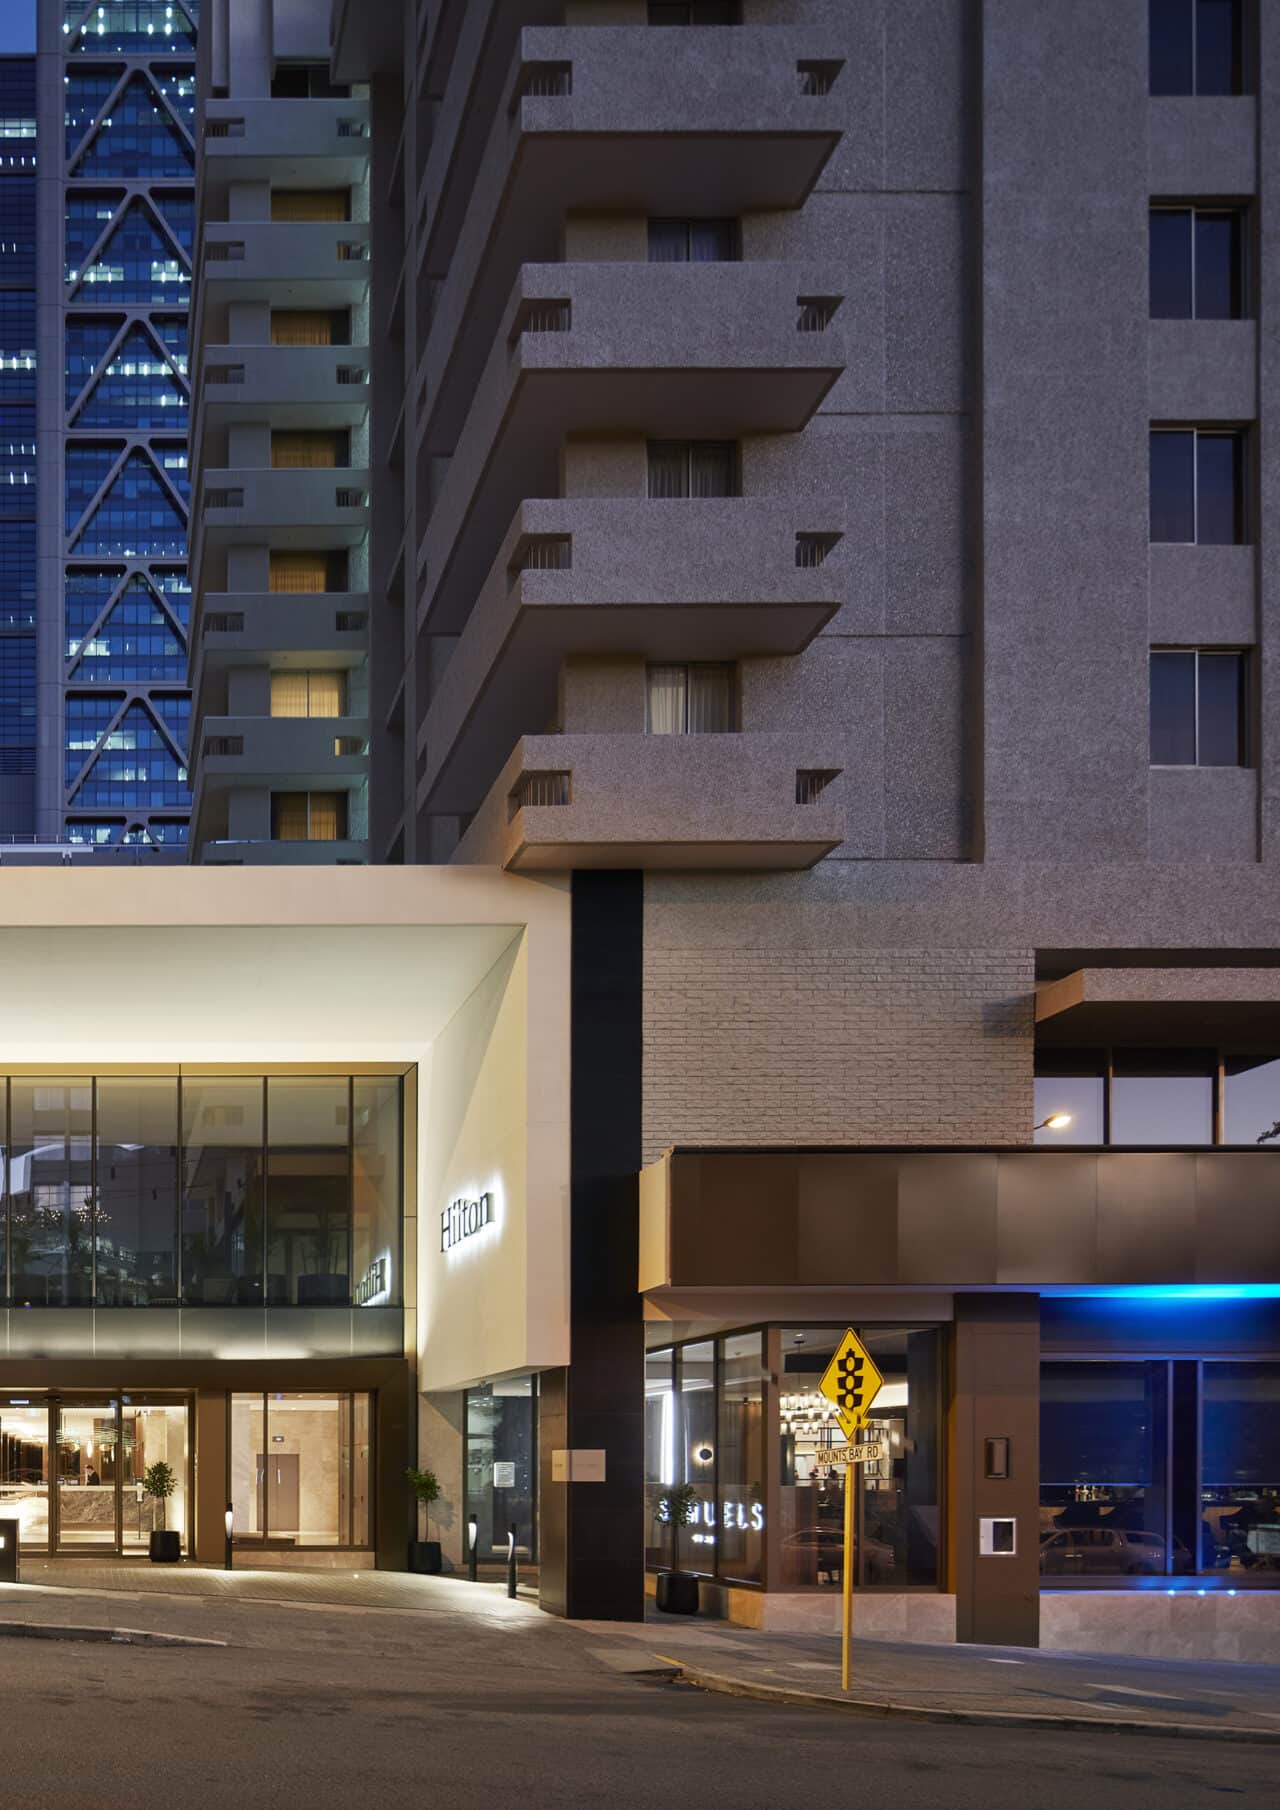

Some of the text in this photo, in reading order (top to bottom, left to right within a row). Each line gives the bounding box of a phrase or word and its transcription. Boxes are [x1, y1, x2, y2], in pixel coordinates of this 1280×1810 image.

[440, 1191, 496, 1253] Hilton
[817, 1445, 879, 1464] MOUNTS BAY RD
